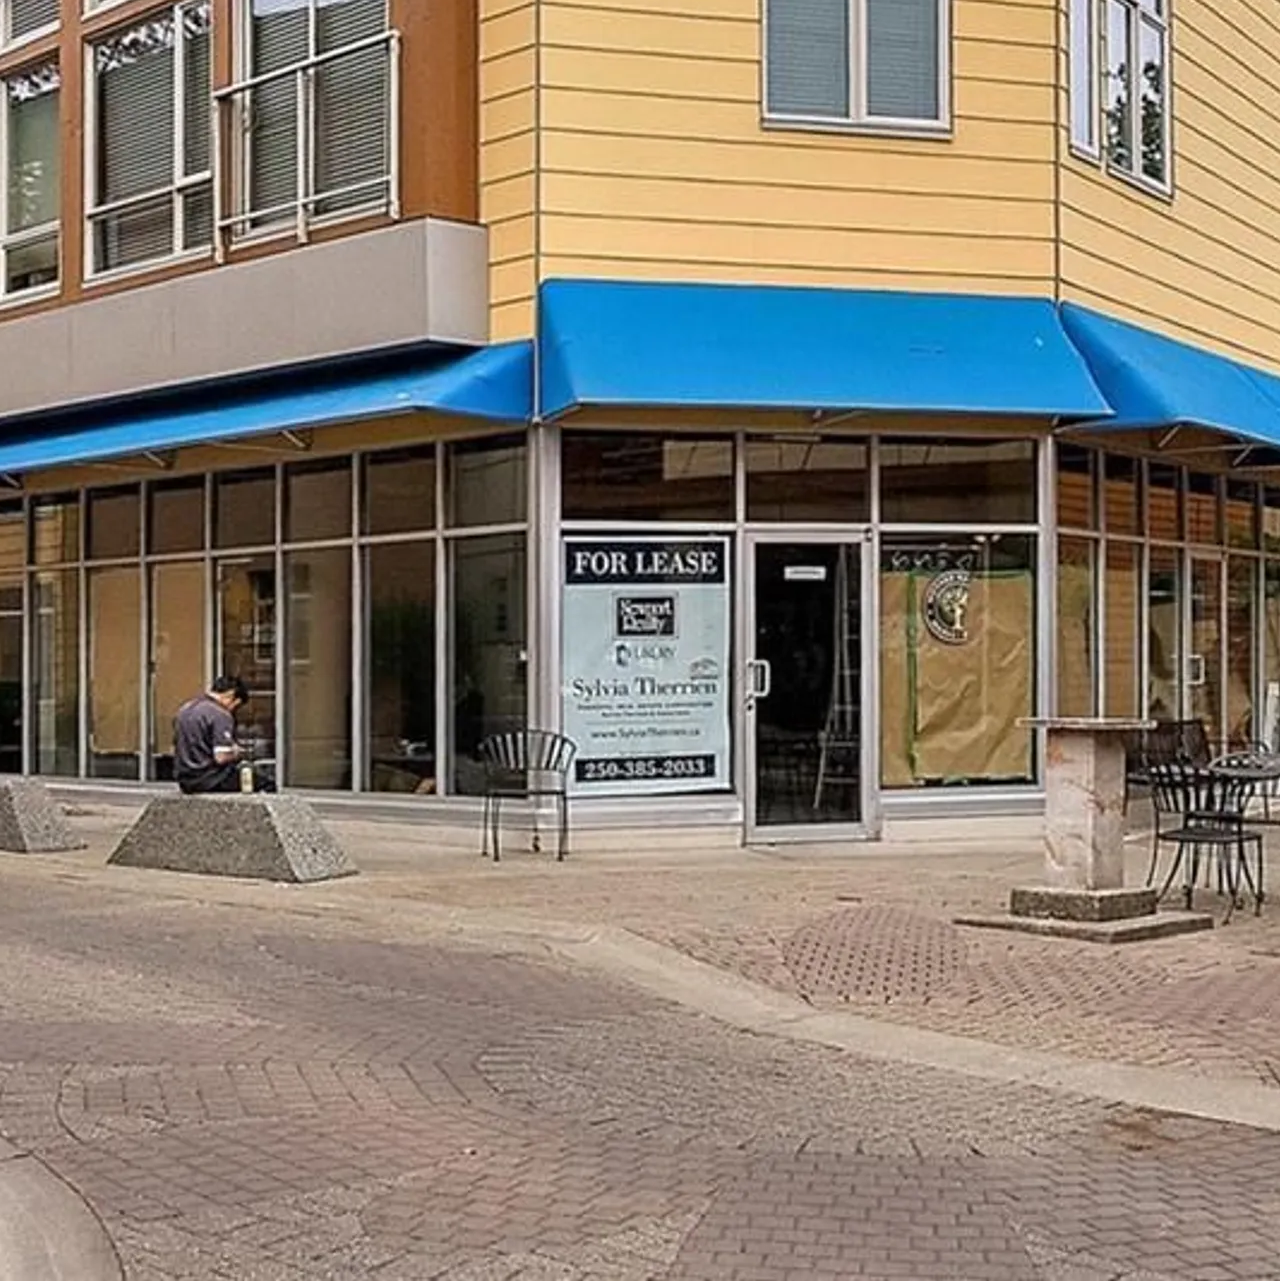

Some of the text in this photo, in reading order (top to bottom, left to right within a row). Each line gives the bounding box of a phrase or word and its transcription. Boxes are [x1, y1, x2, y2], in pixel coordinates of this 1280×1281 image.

[574, 551, 718, 575] FOR LEASE
[572, 676, 717, 701] Sylvia Therrien
